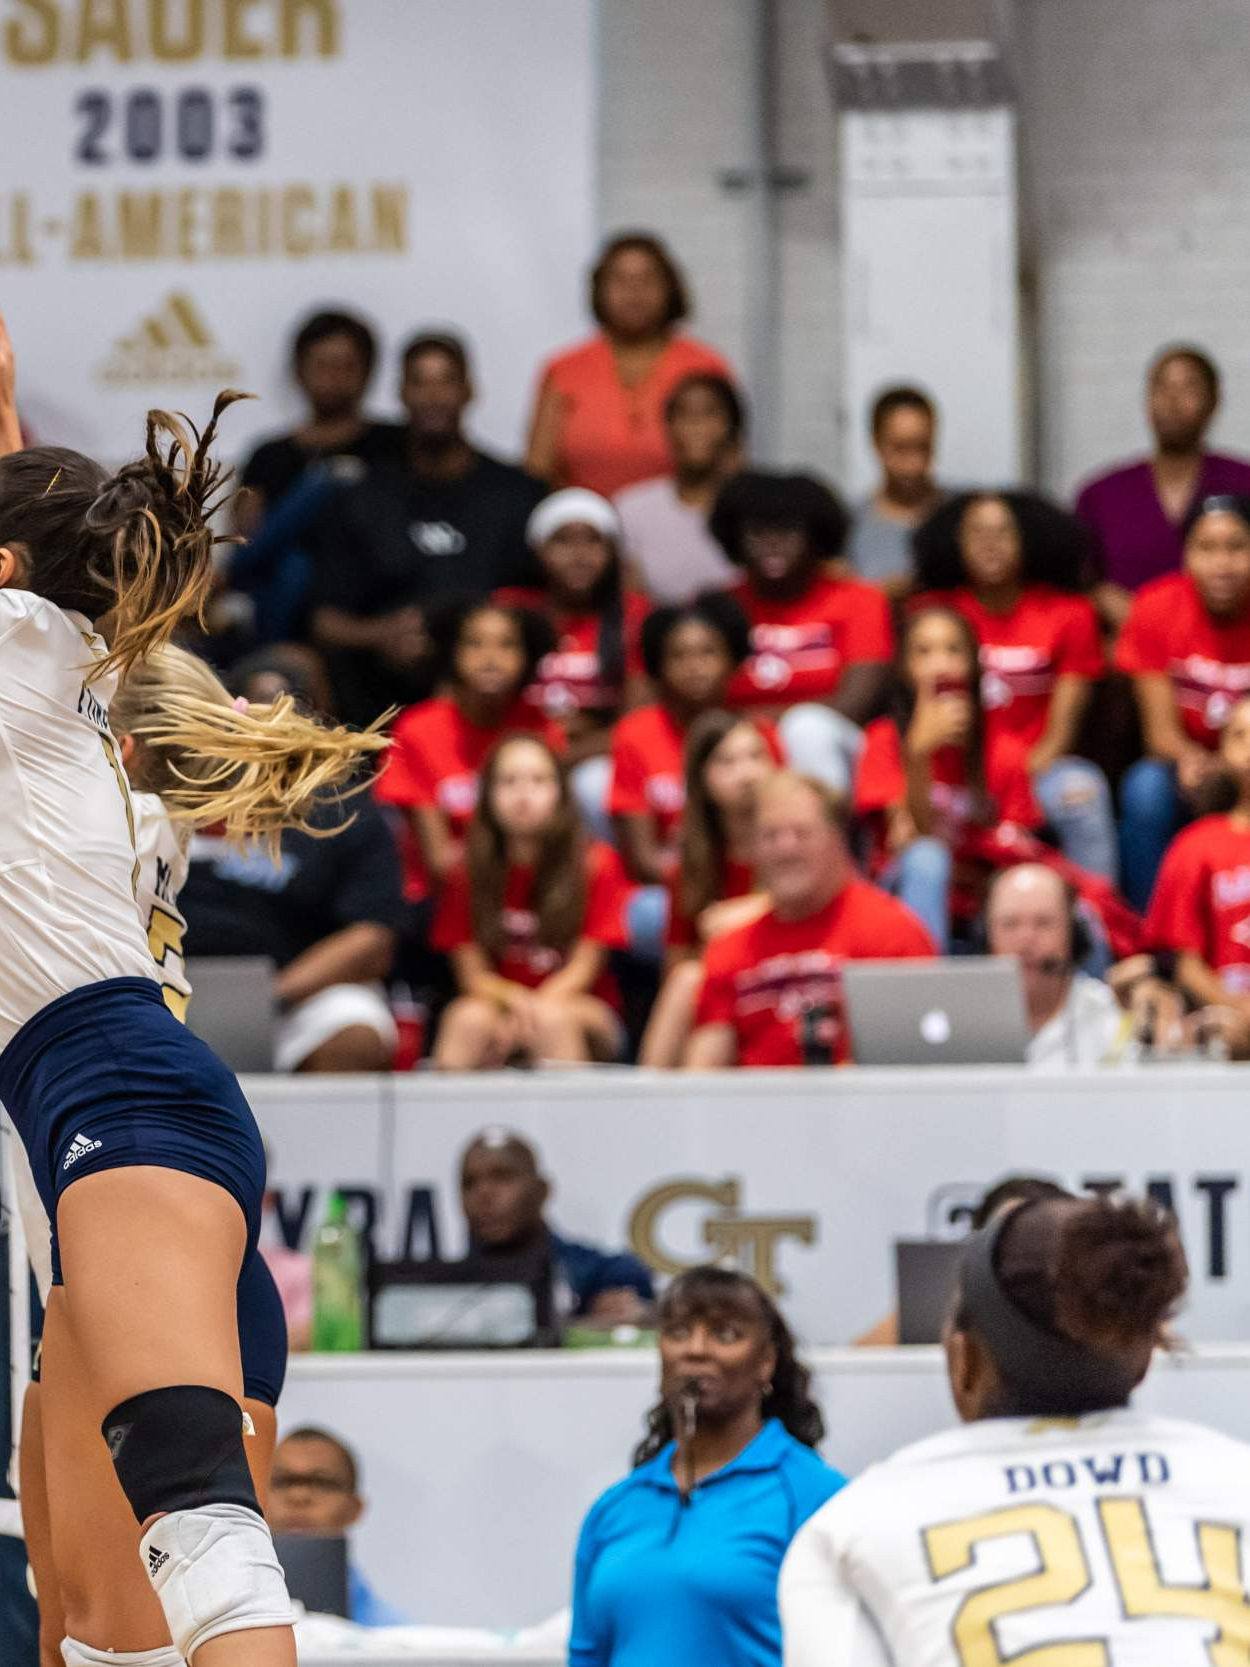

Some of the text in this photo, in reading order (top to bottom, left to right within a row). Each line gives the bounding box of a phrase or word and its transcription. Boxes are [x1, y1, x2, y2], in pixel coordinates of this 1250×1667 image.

[74, 86, 267, 165] 2003
[63, 1140, 102, 1170] adidas
[1004, 1452, 1170, 1493] DOWD
[919, 1495, 1250, 1667] 24
